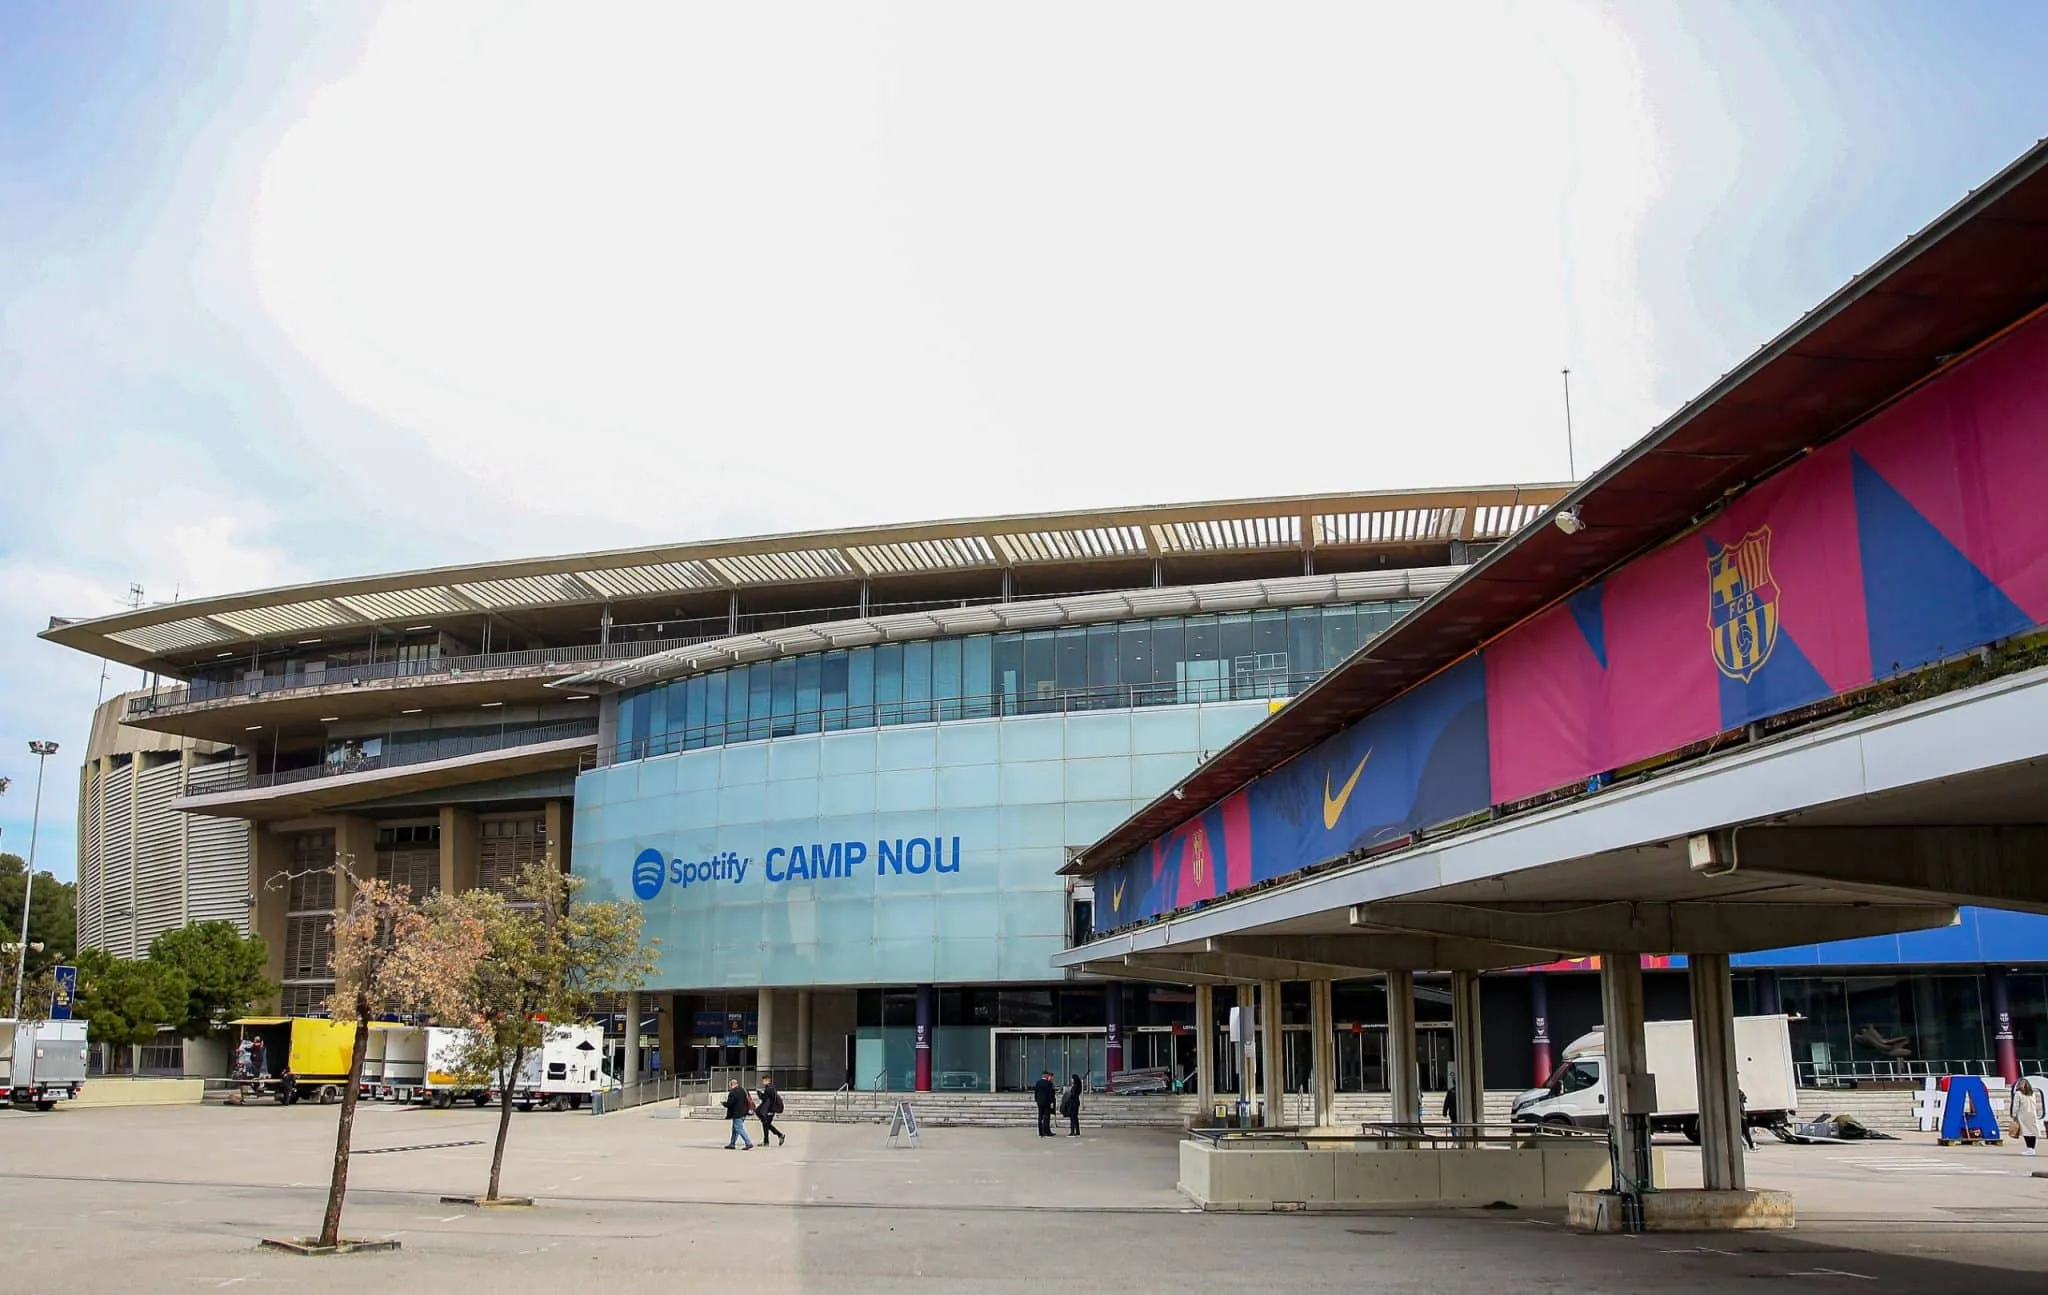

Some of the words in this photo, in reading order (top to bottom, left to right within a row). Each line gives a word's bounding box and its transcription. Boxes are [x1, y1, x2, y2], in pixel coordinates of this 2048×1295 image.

[1729, 593, 1754, 619] FCB
[670, 852, 749, 888] Spotify
[766, 842, 866, 881] CAMP
[878, 837, 960, 875] NOU
